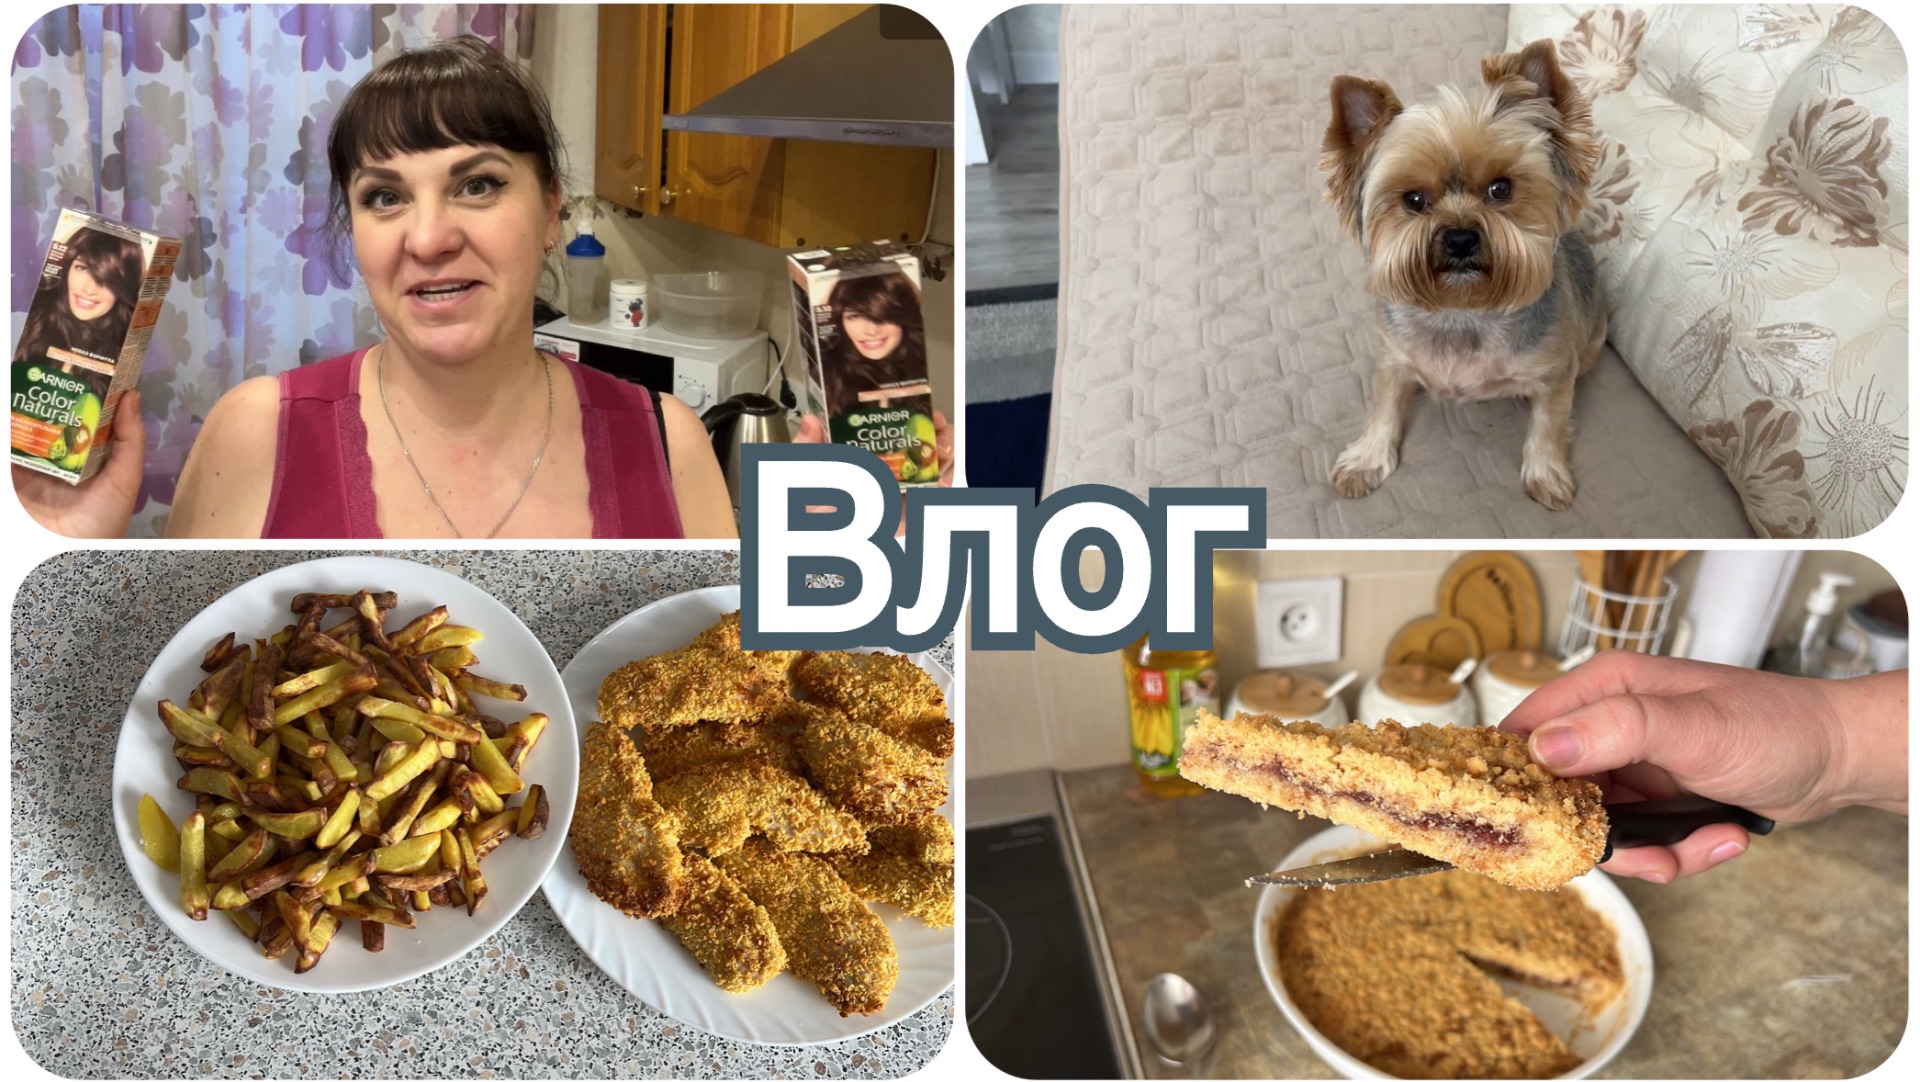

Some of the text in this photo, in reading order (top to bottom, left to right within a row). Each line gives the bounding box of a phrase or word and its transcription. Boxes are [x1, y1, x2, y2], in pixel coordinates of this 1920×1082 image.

[28, 368, 85, 395] GARNIER
[12, 392, 84, 428] naturals
[28, 386, 77, 411] Color
[850, 410, 910, 425] GARNIER
[857, 425, 908, 441] Color
